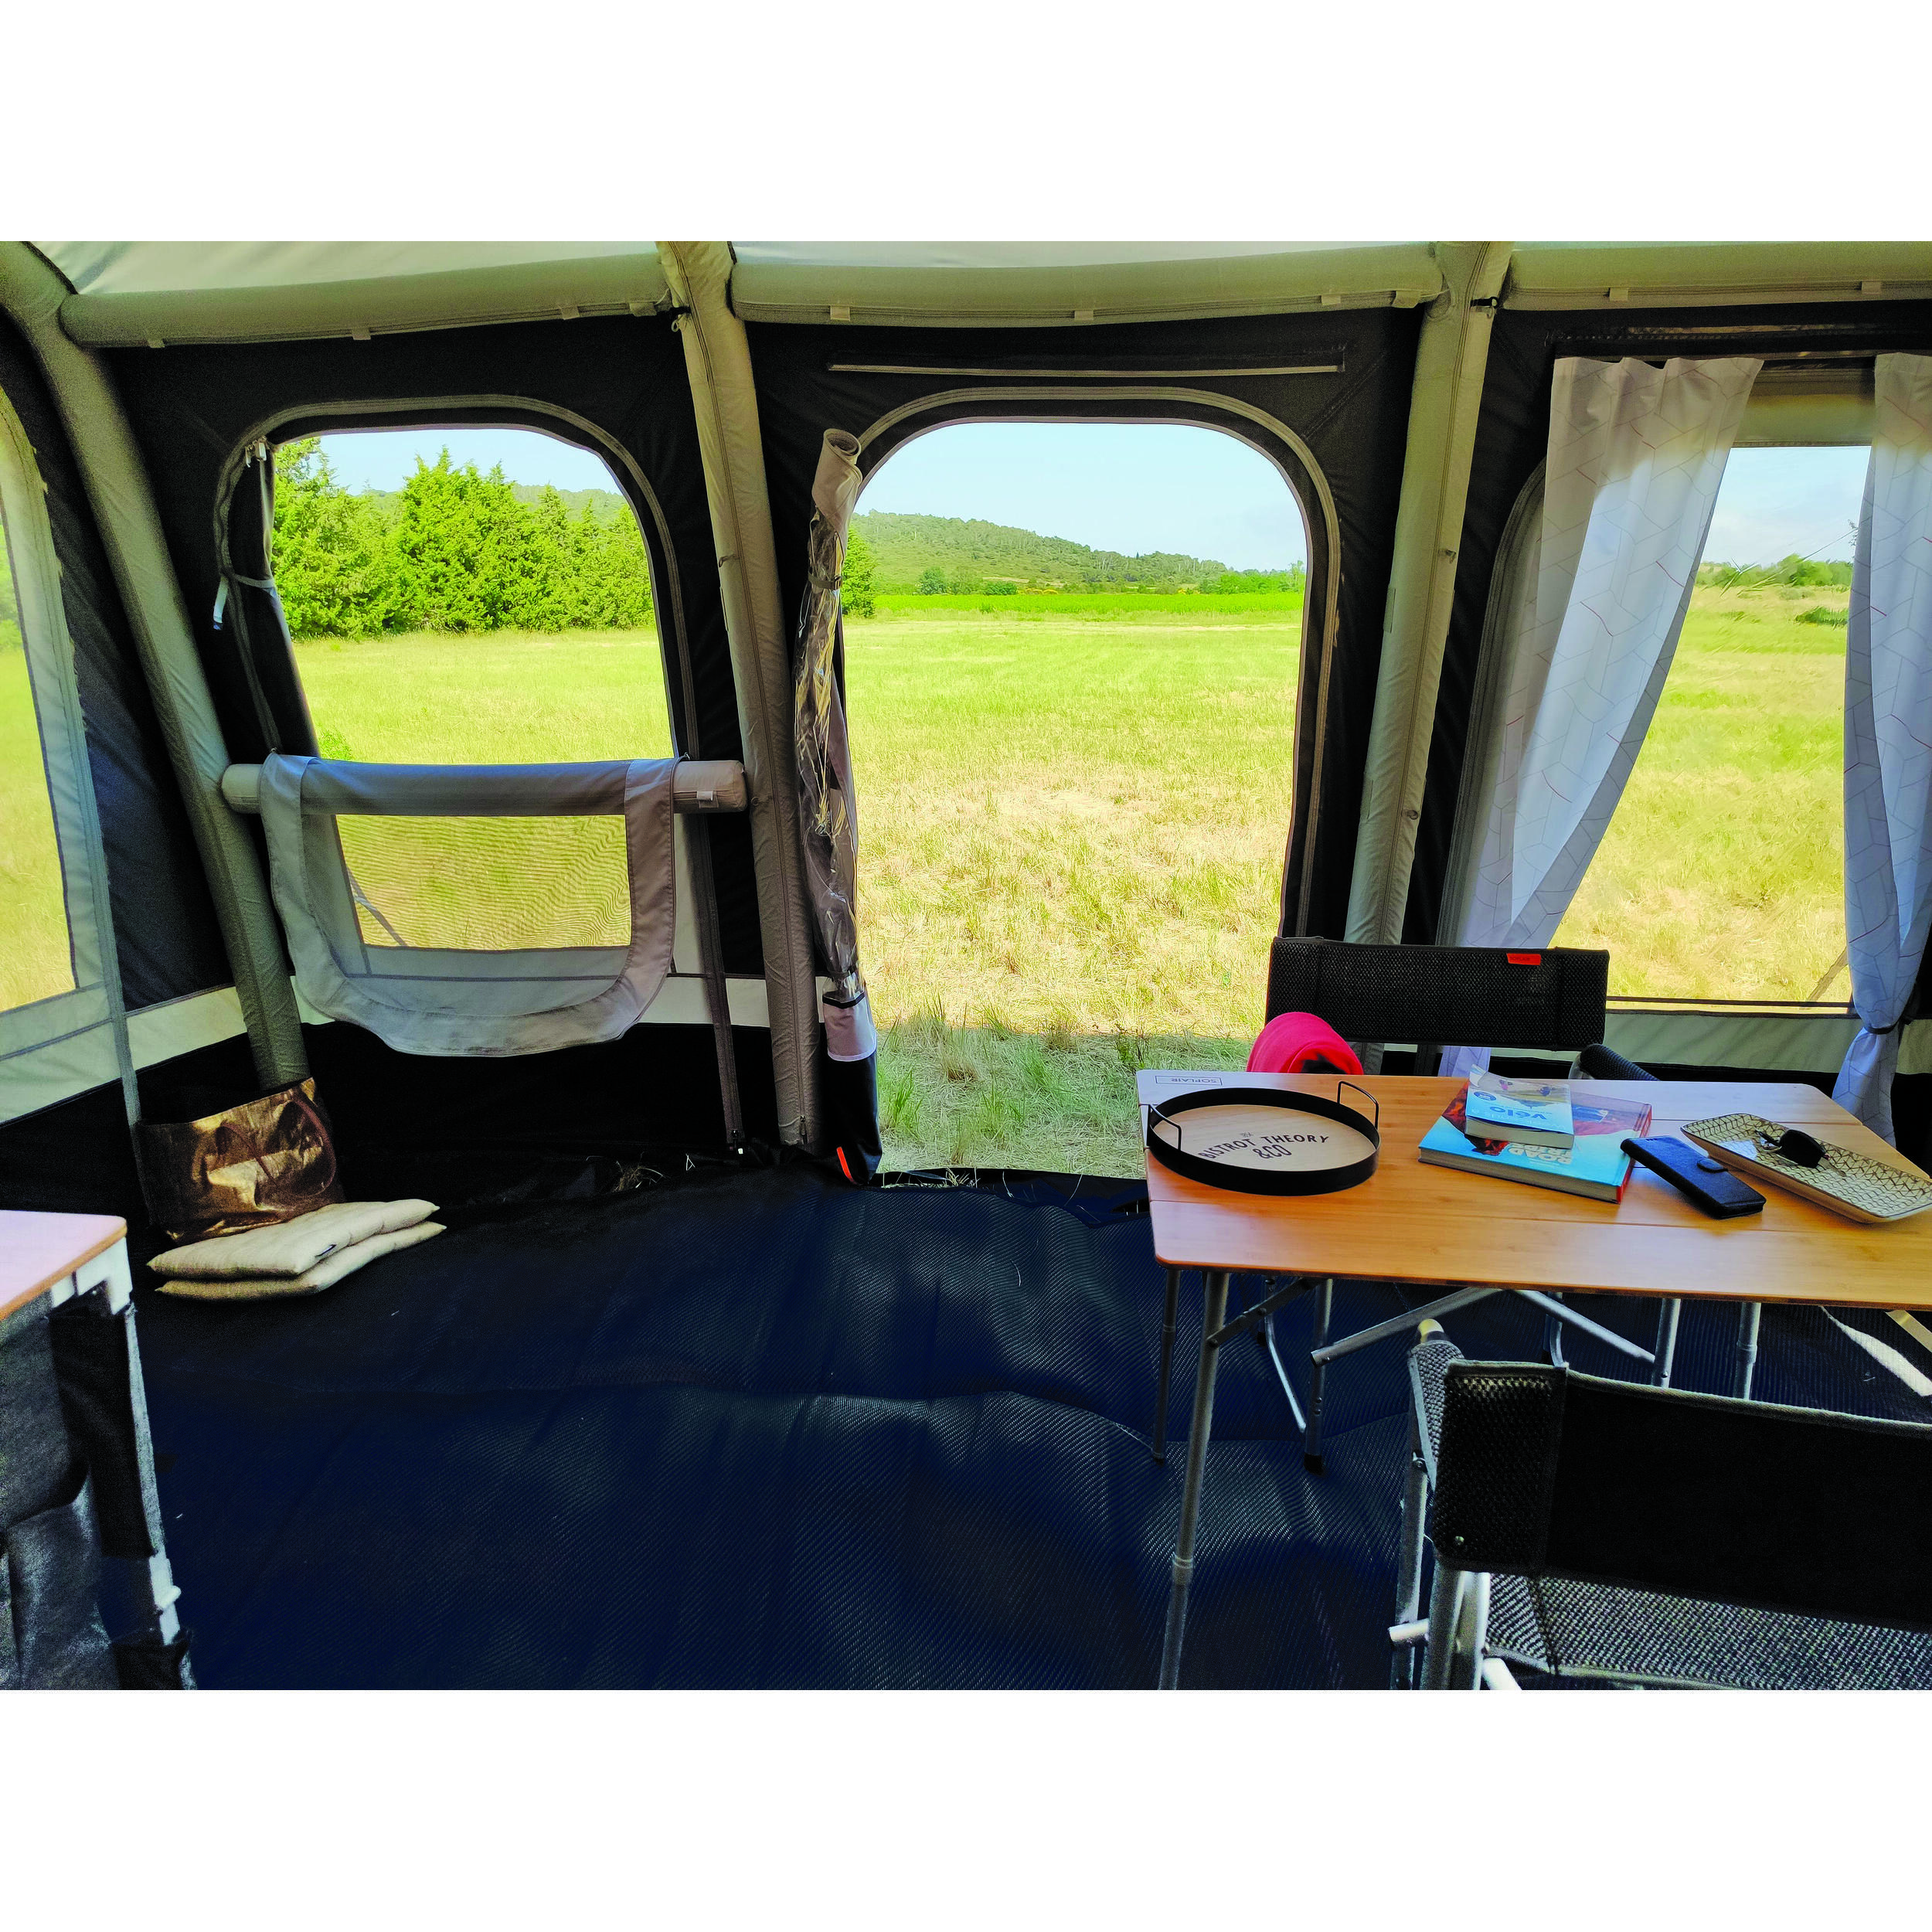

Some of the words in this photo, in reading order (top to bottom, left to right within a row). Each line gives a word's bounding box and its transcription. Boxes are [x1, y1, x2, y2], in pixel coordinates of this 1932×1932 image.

[1489, 1107, 1546, 1121] vélo
[1198, 1138, 1256, 1158] BISTROT
[1260, 1134, 1329, 1144] THEORY
[1253, 1144, 1292, 1158] &CO
[1509, 1148, 1571, 1165] ROAD
